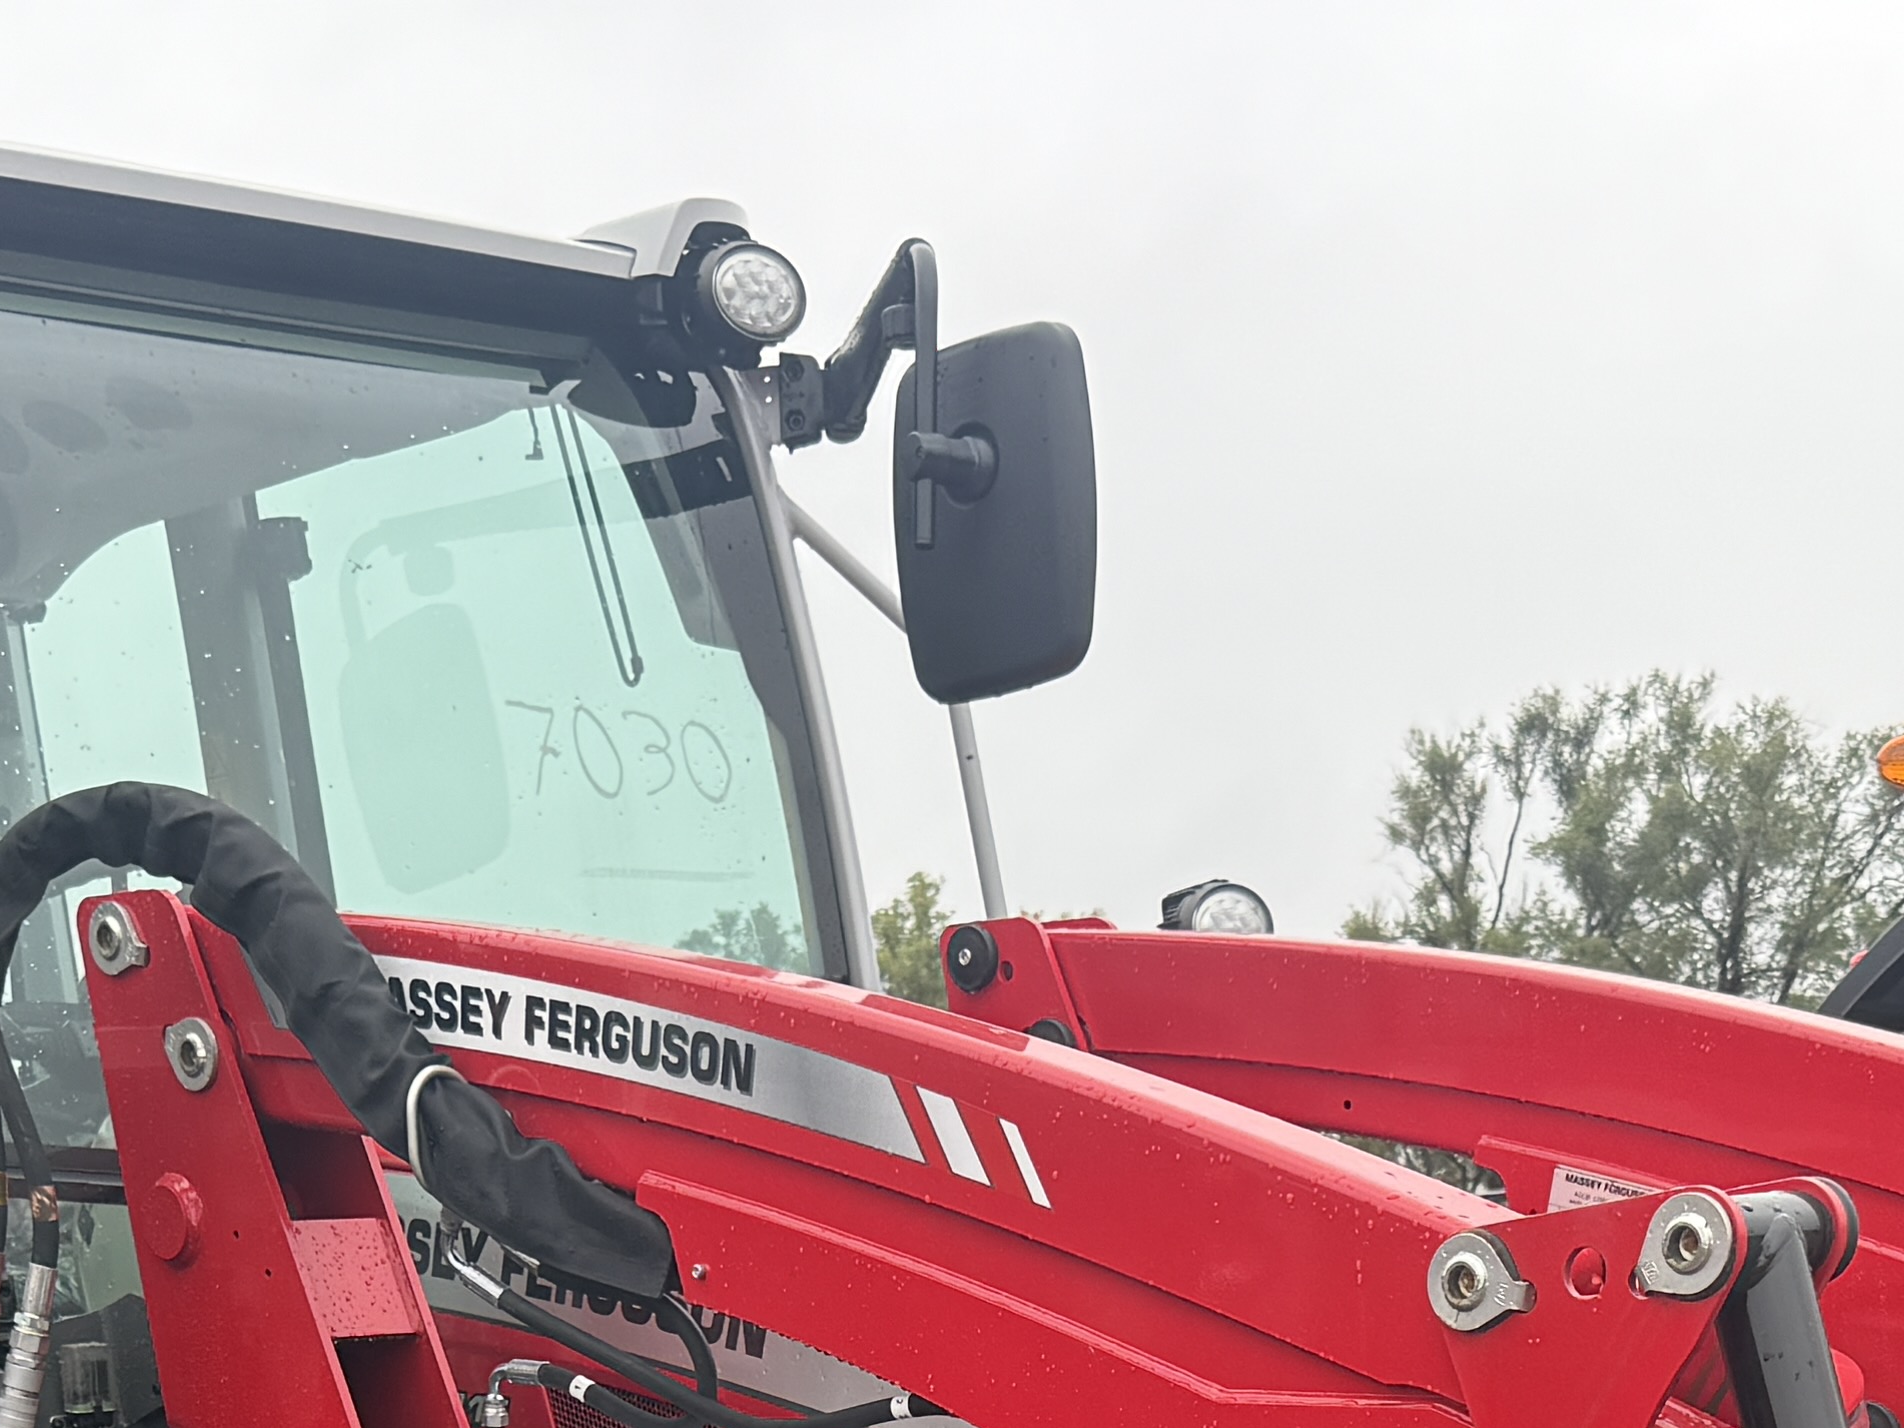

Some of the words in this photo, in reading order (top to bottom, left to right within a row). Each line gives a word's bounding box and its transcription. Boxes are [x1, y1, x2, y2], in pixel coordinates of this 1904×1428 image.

[505, 699, 733, 804] 7030
[388, 976, 512, 1041] ASSEY
[523, 993, 758, 1098] FERGUSON
